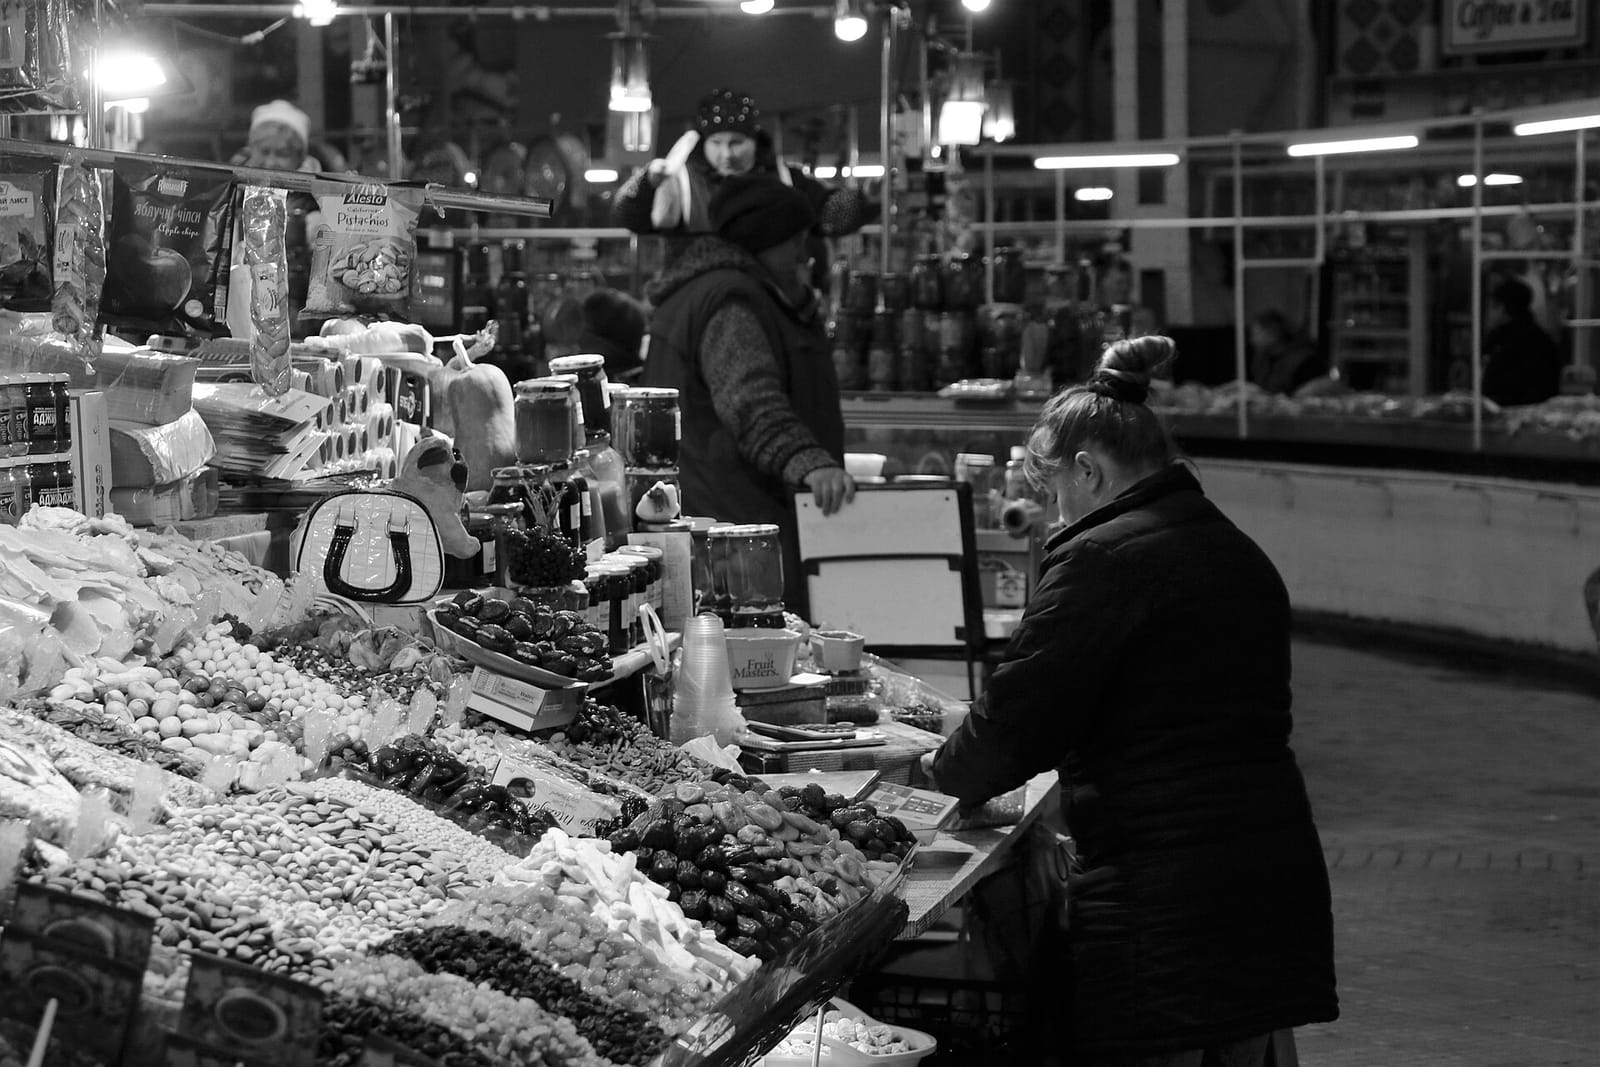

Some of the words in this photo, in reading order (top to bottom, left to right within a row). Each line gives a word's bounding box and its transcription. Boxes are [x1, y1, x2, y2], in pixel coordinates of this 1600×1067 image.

[347, 193, 383, 204] Alesto
[337, 211, 389, 227] Pistachios
[747, 659, 774, 670] Fruit
[733, 667, 777, 679] Masters
